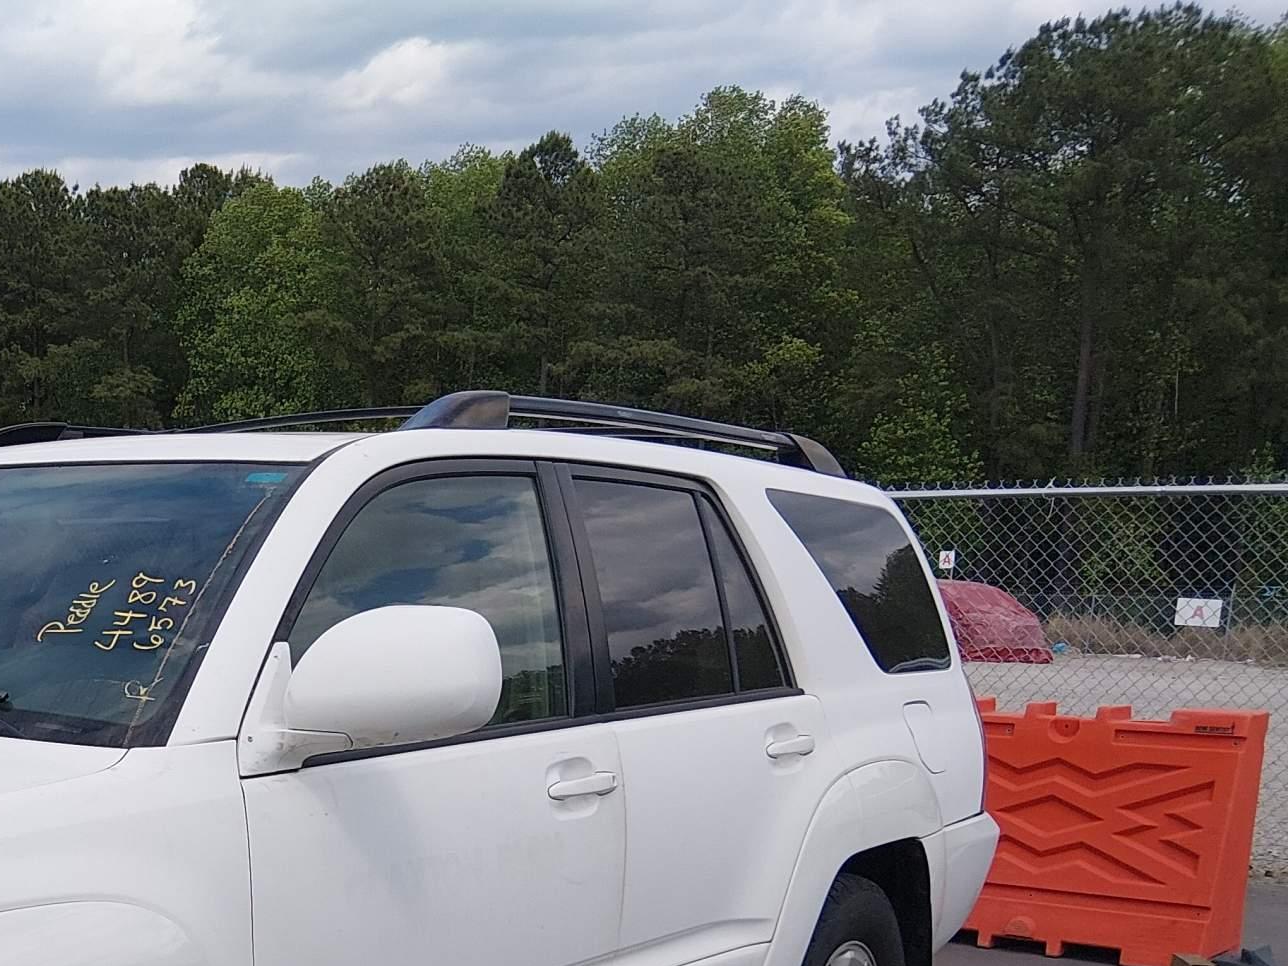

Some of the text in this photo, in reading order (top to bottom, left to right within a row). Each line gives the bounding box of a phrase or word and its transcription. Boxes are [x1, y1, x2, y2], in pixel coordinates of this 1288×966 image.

[93, 572, 165, 651] 4489
[133, 579, 197, 651] 6573
[1192, 605, 1205, 620] A
